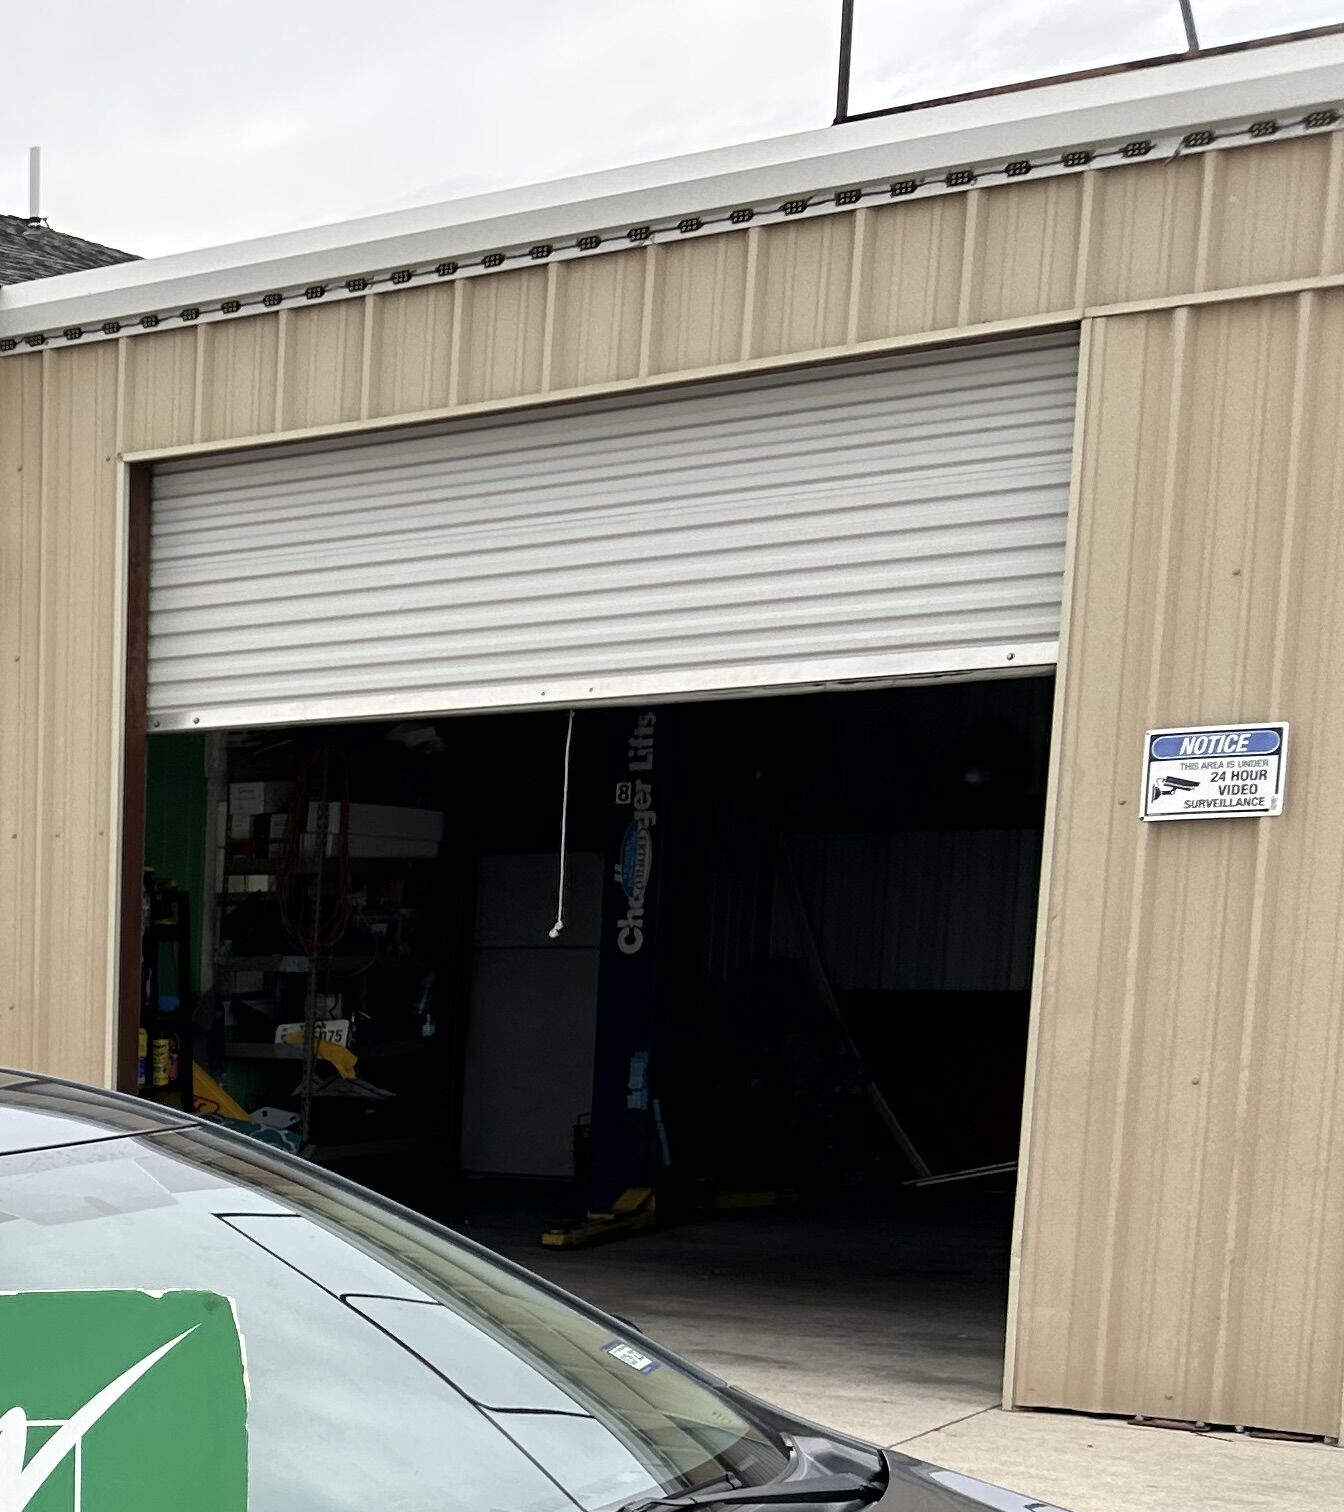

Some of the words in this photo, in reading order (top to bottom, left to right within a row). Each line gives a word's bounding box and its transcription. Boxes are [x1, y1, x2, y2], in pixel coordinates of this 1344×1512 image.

[626, 711, 657, 772] Lifts
[1179, 733, 1252, 756] NOTICE
[1179, 761, 1199, 771] THIS
[1201, 760, 1224, 770] AREA
[1226, 760, 1236, 769] IS
[1237, 759, 1269, 768] UNDER
[1210, 771, 1227, 783] 24
[1231, 770, 1268, 782] HOUR
[1218, 783, 1258, 796] VIDEO
[1183, 796, 1265, 809] SURVEILLANCE
